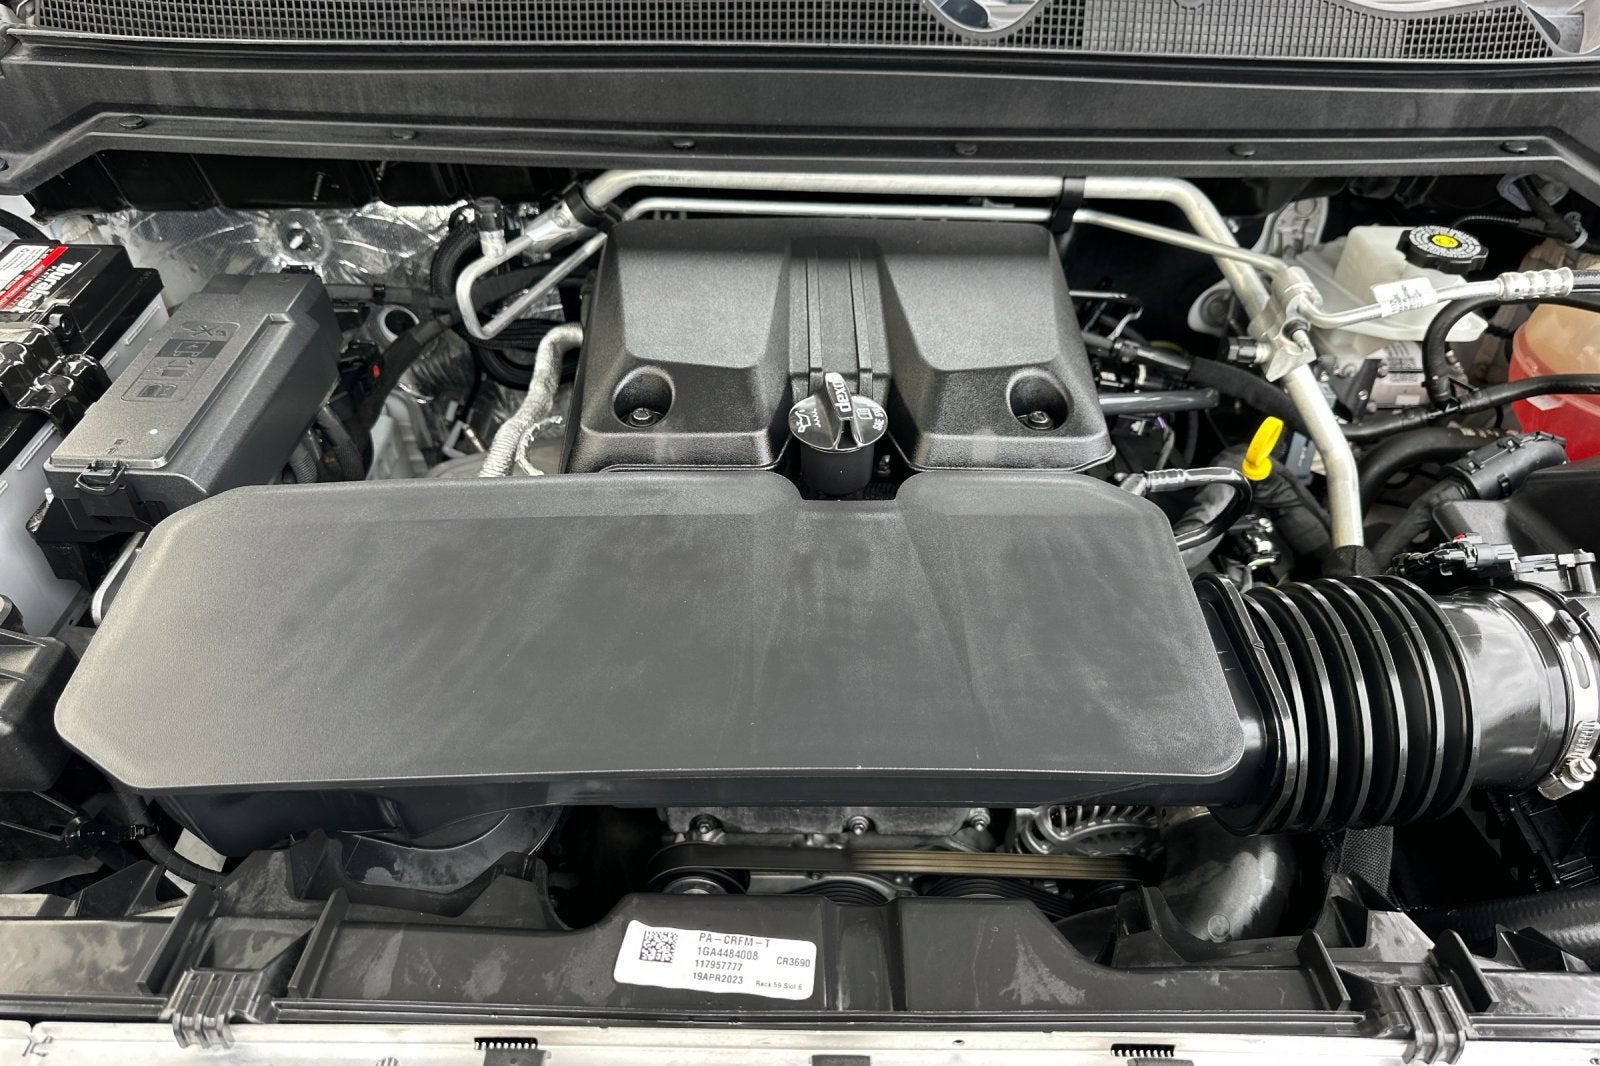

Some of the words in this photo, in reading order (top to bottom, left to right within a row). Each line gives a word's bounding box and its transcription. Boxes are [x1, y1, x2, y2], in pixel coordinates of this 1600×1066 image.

[15, 262, 82, 313] Duralast
[833, 376, 851, 412] dexo
[699, 932, 771, 948] PA-CRFM-T
[697, 946, 759, 961] 1GA4484008
[695, 959, 743, 971] 117957777
[776, 956, 811, 968] CR3690
[693, 972, 744, 985] 19APR2023
